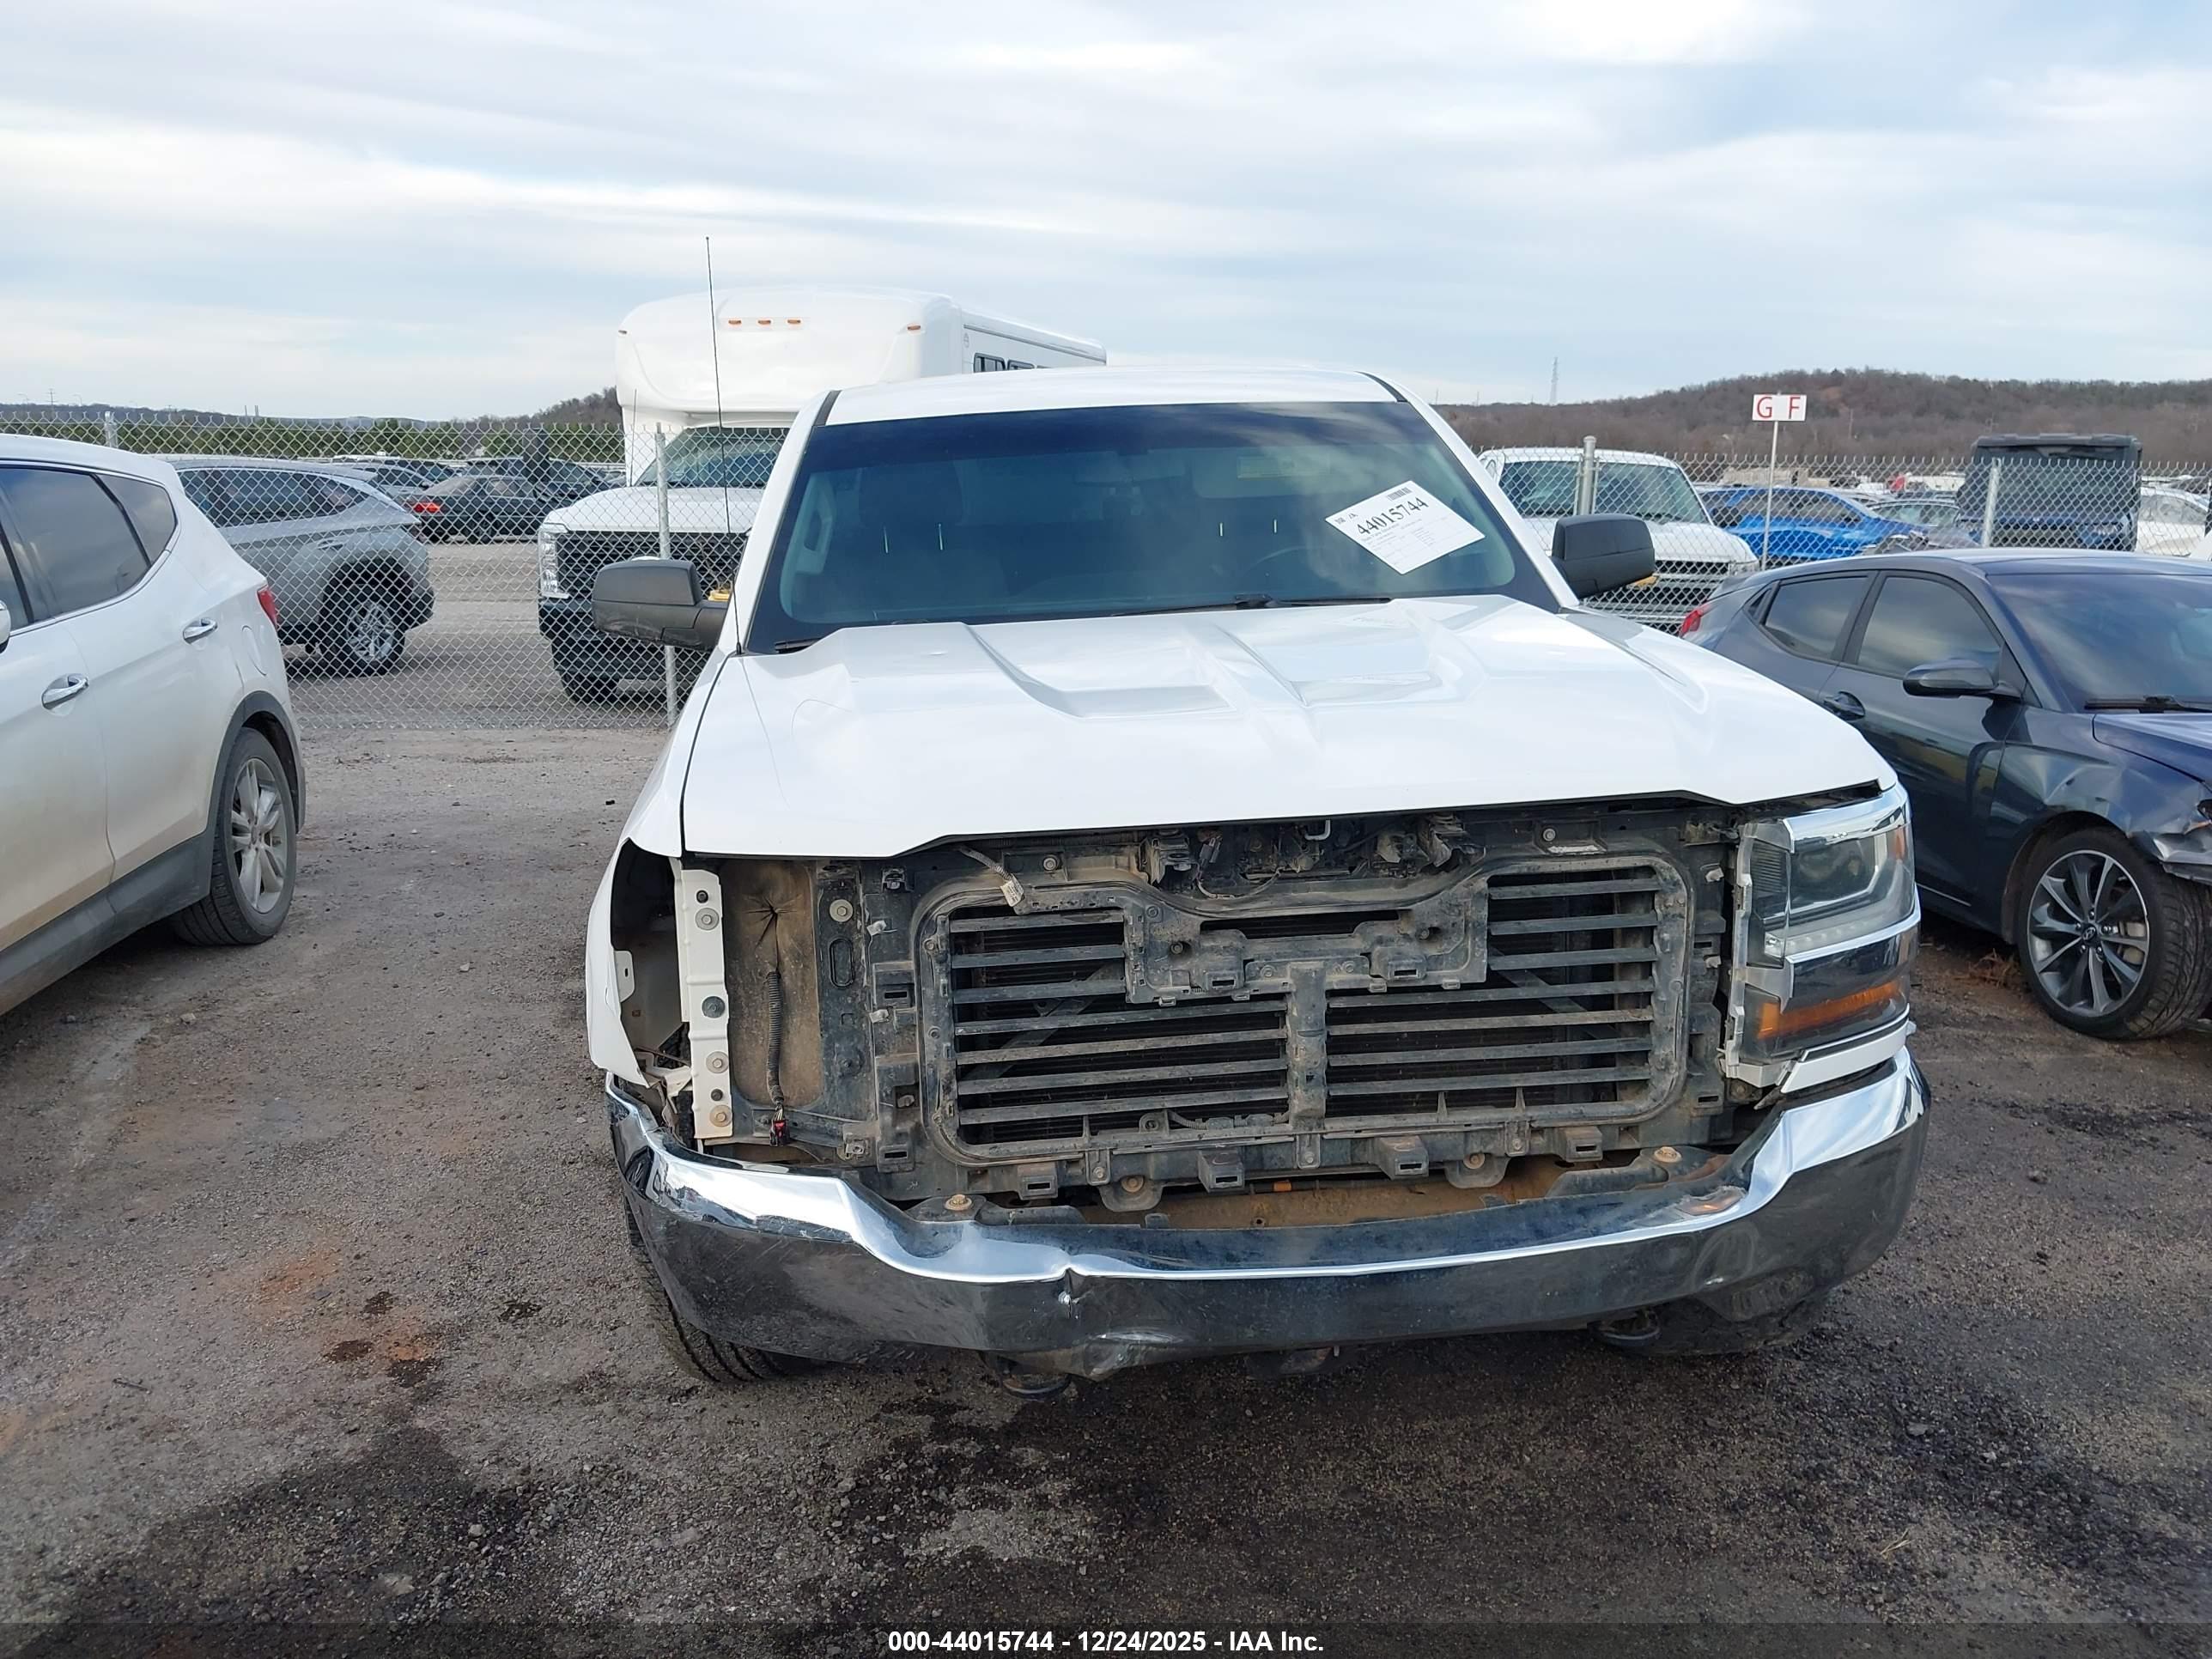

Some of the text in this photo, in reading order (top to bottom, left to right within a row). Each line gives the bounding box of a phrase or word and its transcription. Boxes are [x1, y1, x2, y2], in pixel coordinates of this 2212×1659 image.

[1757, 397, 1801, 419] G F
[1356, 496, 1430, 535] 44015744
